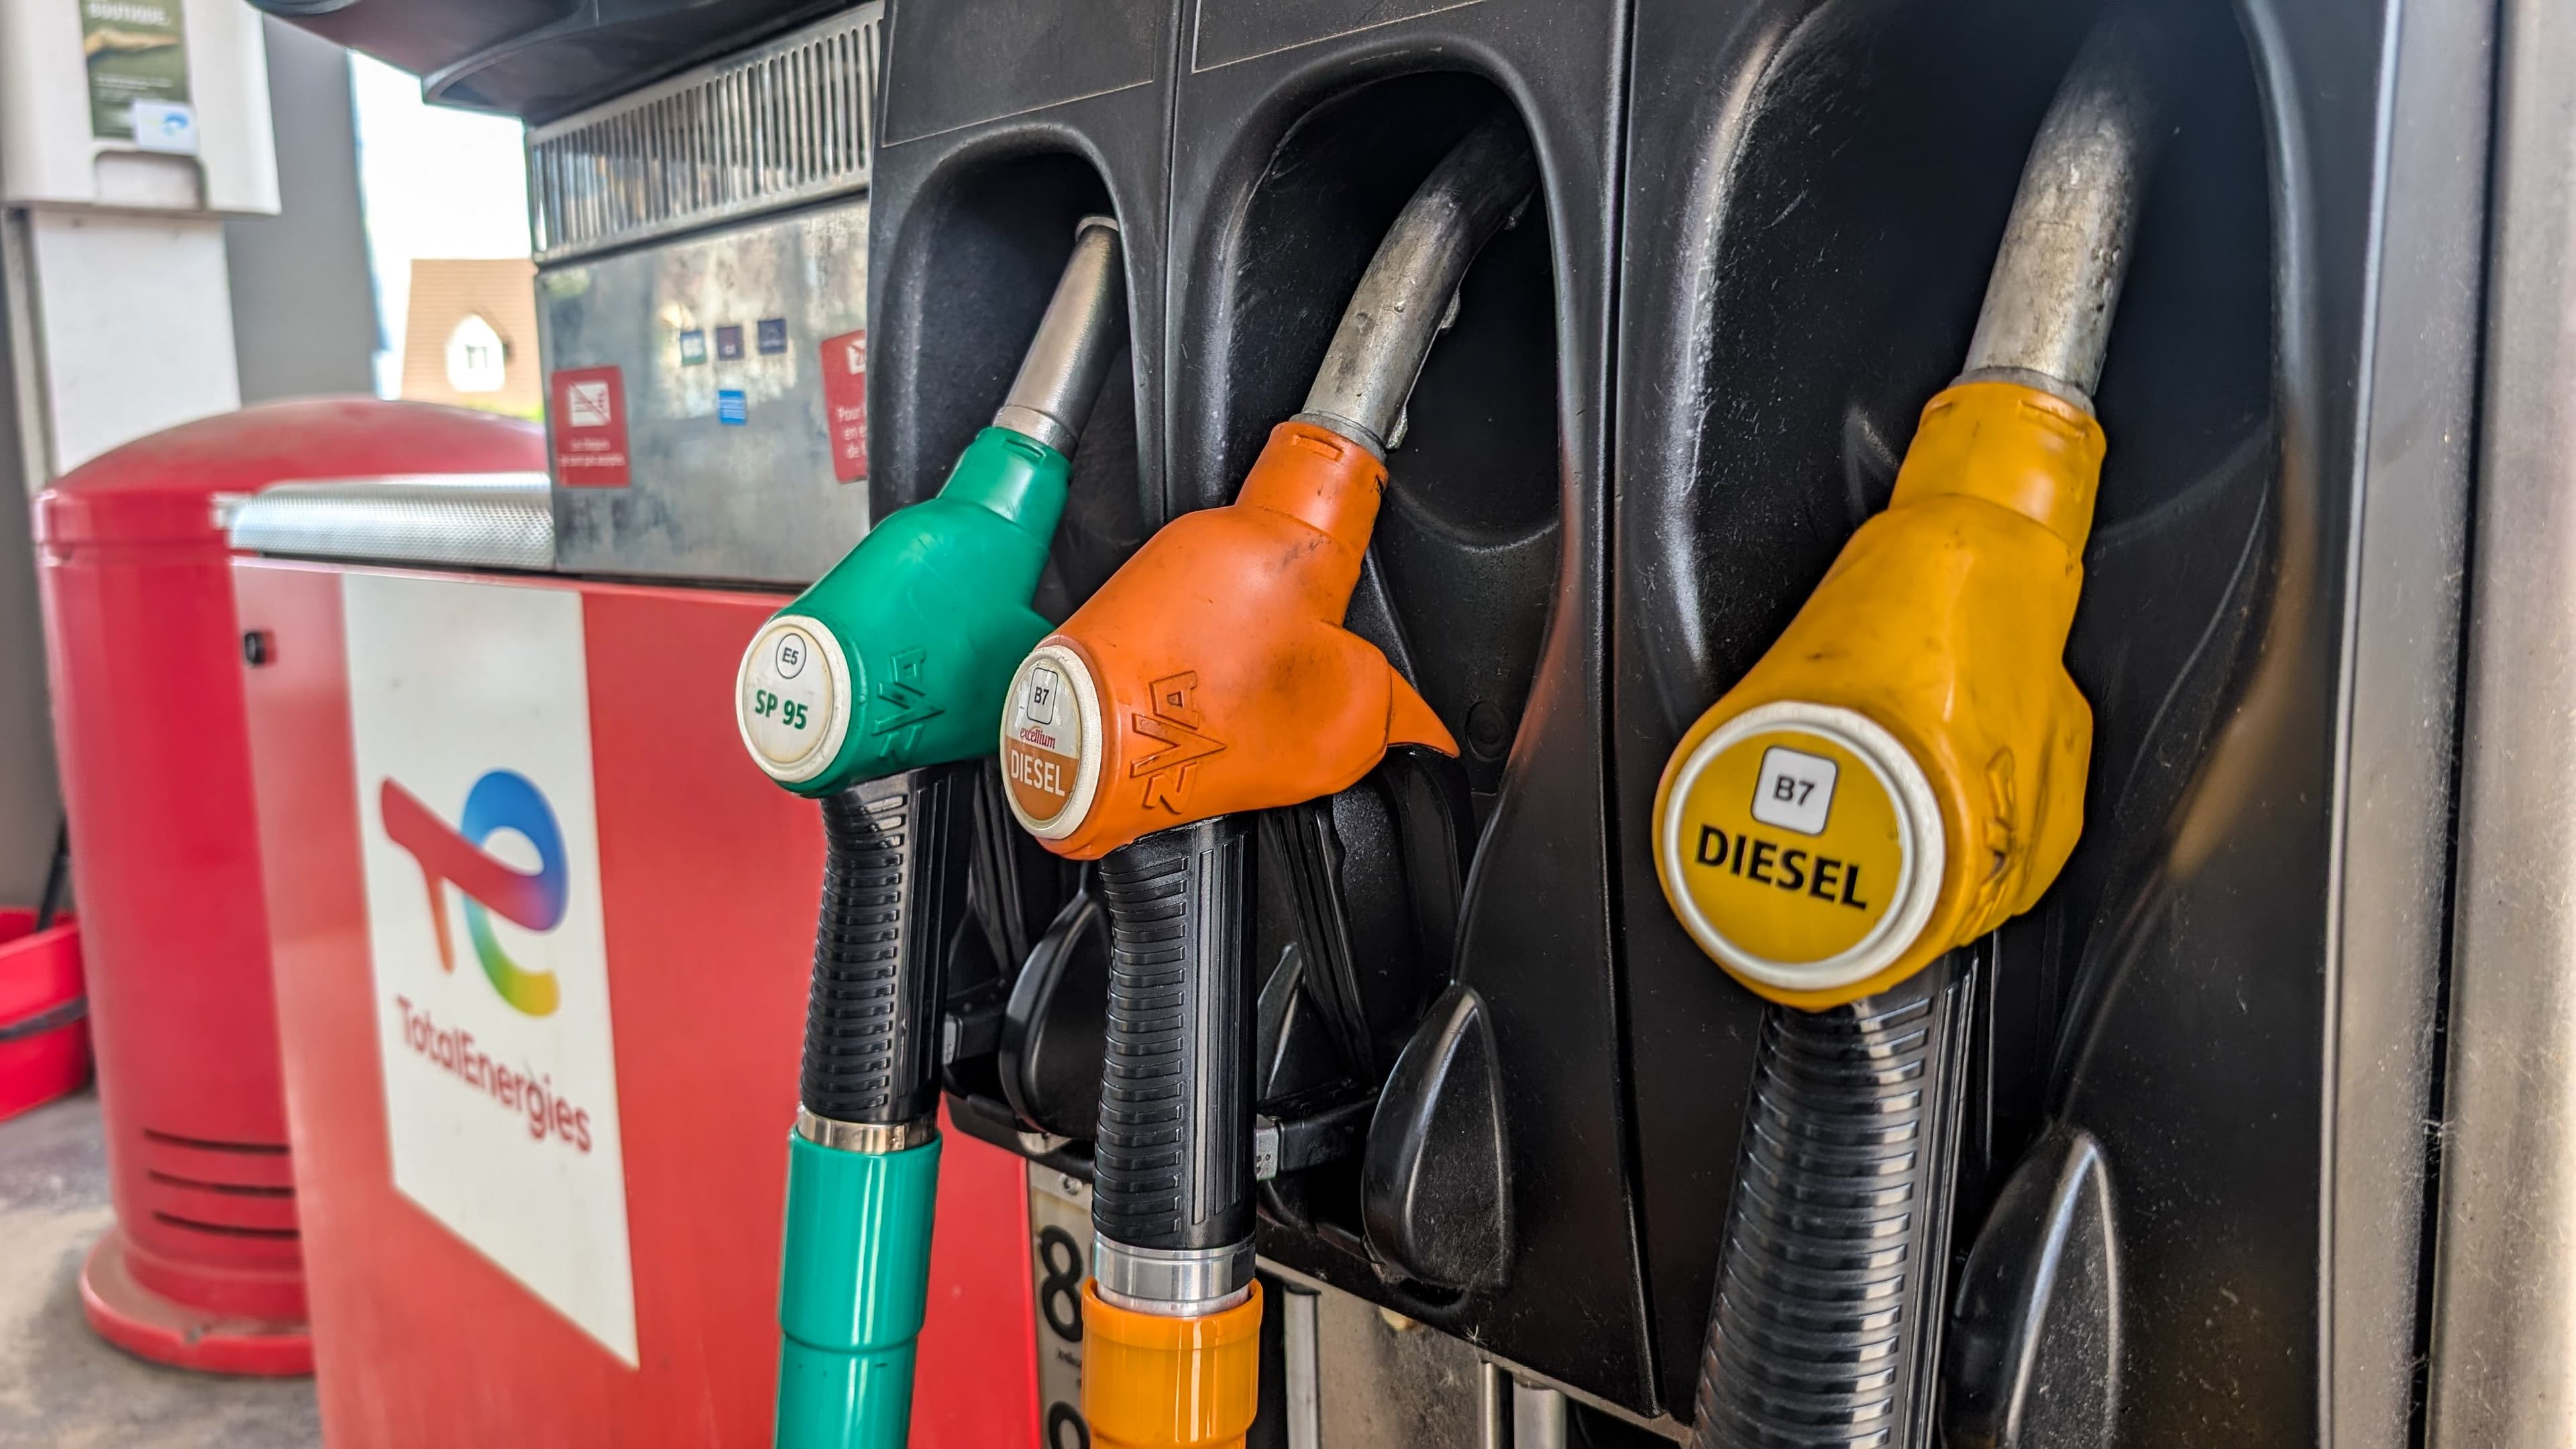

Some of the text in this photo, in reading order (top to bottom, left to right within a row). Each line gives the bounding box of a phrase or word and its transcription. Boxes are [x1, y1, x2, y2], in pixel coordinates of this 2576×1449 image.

[782, 647, 799, 666] E5
[755, 688, 809, 730] SP 95
[1033, 686, 1050, 706] B7
[1020, 726, 1056, 750] excellium
[1011, 750, 1066, 797] DIESEL
[1772, 775, 1816, 807] B7
[1695, 825, 1868, 910] DIESEL
[396, 995, 593, 1153] TotalEnergies
